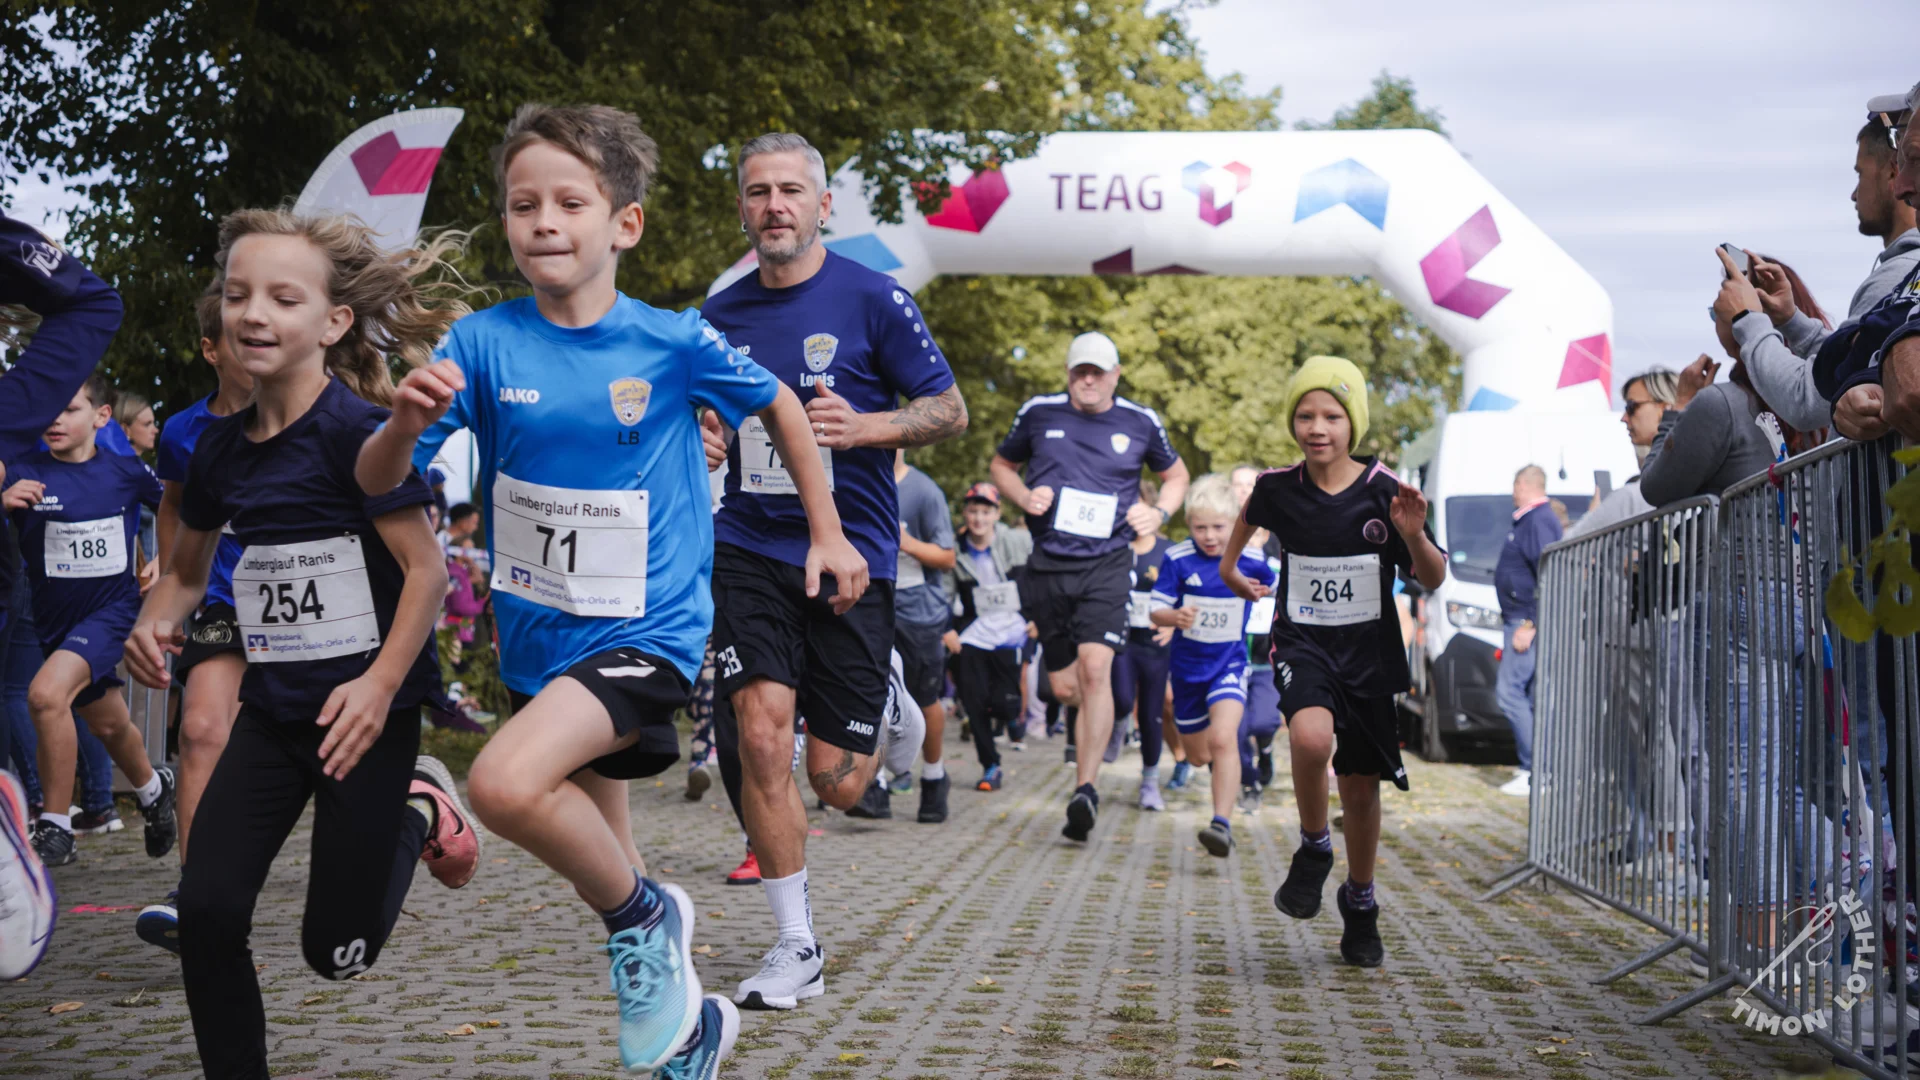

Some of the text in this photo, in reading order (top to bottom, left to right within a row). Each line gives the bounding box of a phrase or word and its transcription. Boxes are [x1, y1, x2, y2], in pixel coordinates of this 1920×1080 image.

[1049, 174, 1163, 211] TEAG
[499, 387, 540, 404] JAKO
[617, 431, 640, 445] LB
[765, 442, 785, 468] 7
[509, 490, 621, 518] Limberglauf Ranis
[1078, 505, 1095, 522] 86
[68, 538, 107, 559] 188
[536, 524, 577, 573] 71
[243, 552, 336, 573] Limberglauf Ranis
[1298, 563, 1364, 574] Limberglauf Ranis
[533, 573, 565, 590] Volksbank
[1310, 578, 1354, 603] 264
[259, 579, 325, 624] 254
[1200, 610, 1229, 629] 239
[846, 719, 875, 736] JAKO
